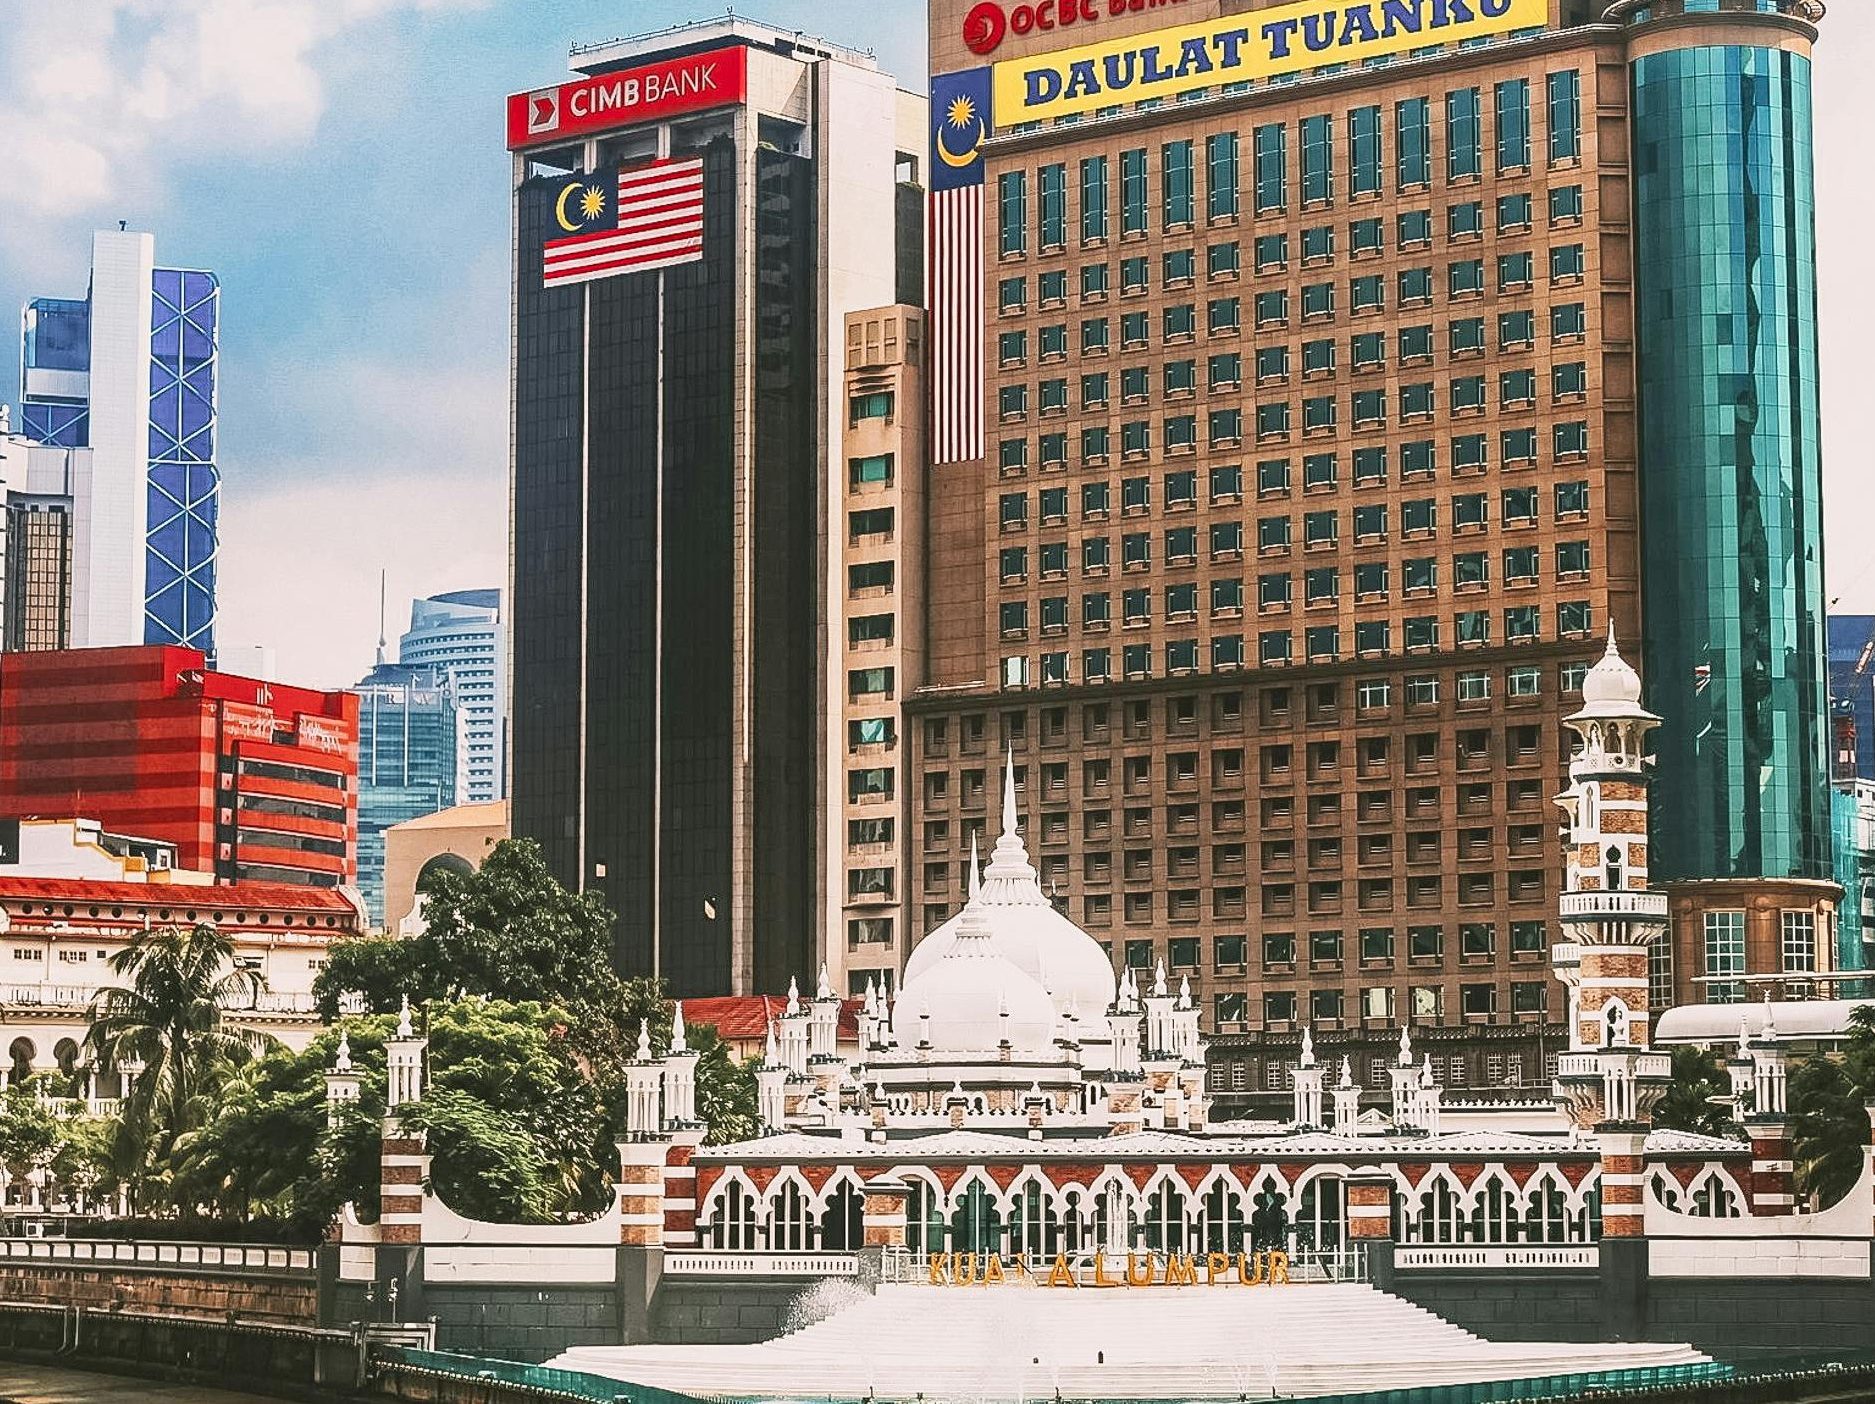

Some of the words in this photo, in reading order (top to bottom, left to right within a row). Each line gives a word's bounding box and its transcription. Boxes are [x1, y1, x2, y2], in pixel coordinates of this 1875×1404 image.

[1010, 0, 1098, 34] OCBC
[569, 79, 640, 118] CIMB
[644, 62, 717, 103] BANK
[1023, 28, 1249, 107] DAULAT
[1095, 1251, 1290, 1287] LUMPUR
